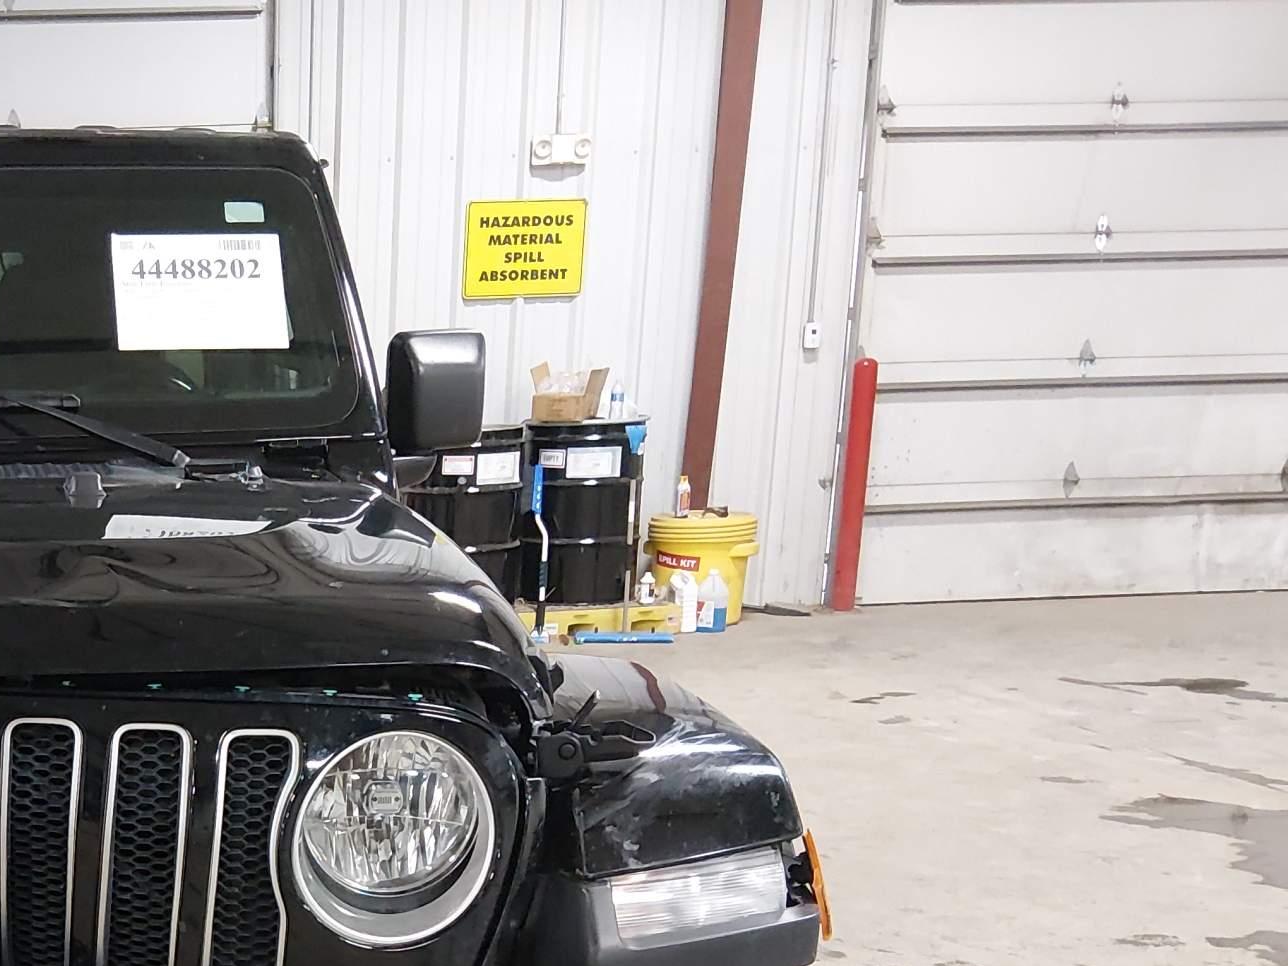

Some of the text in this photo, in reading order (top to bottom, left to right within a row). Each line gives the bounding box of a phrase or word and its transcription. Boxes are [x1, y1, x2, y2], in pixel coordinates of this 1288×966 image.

[480, 215, 574, 228] HAZARDOUS
[488, 233, 562, 246] MATERIAL
[504, 251, 545, 263] SPILL
[131, 258, 261, 280] 44488202
[479, 268, 568, 281] ABSORBENT
[679, 559, 697, 568] KIT
